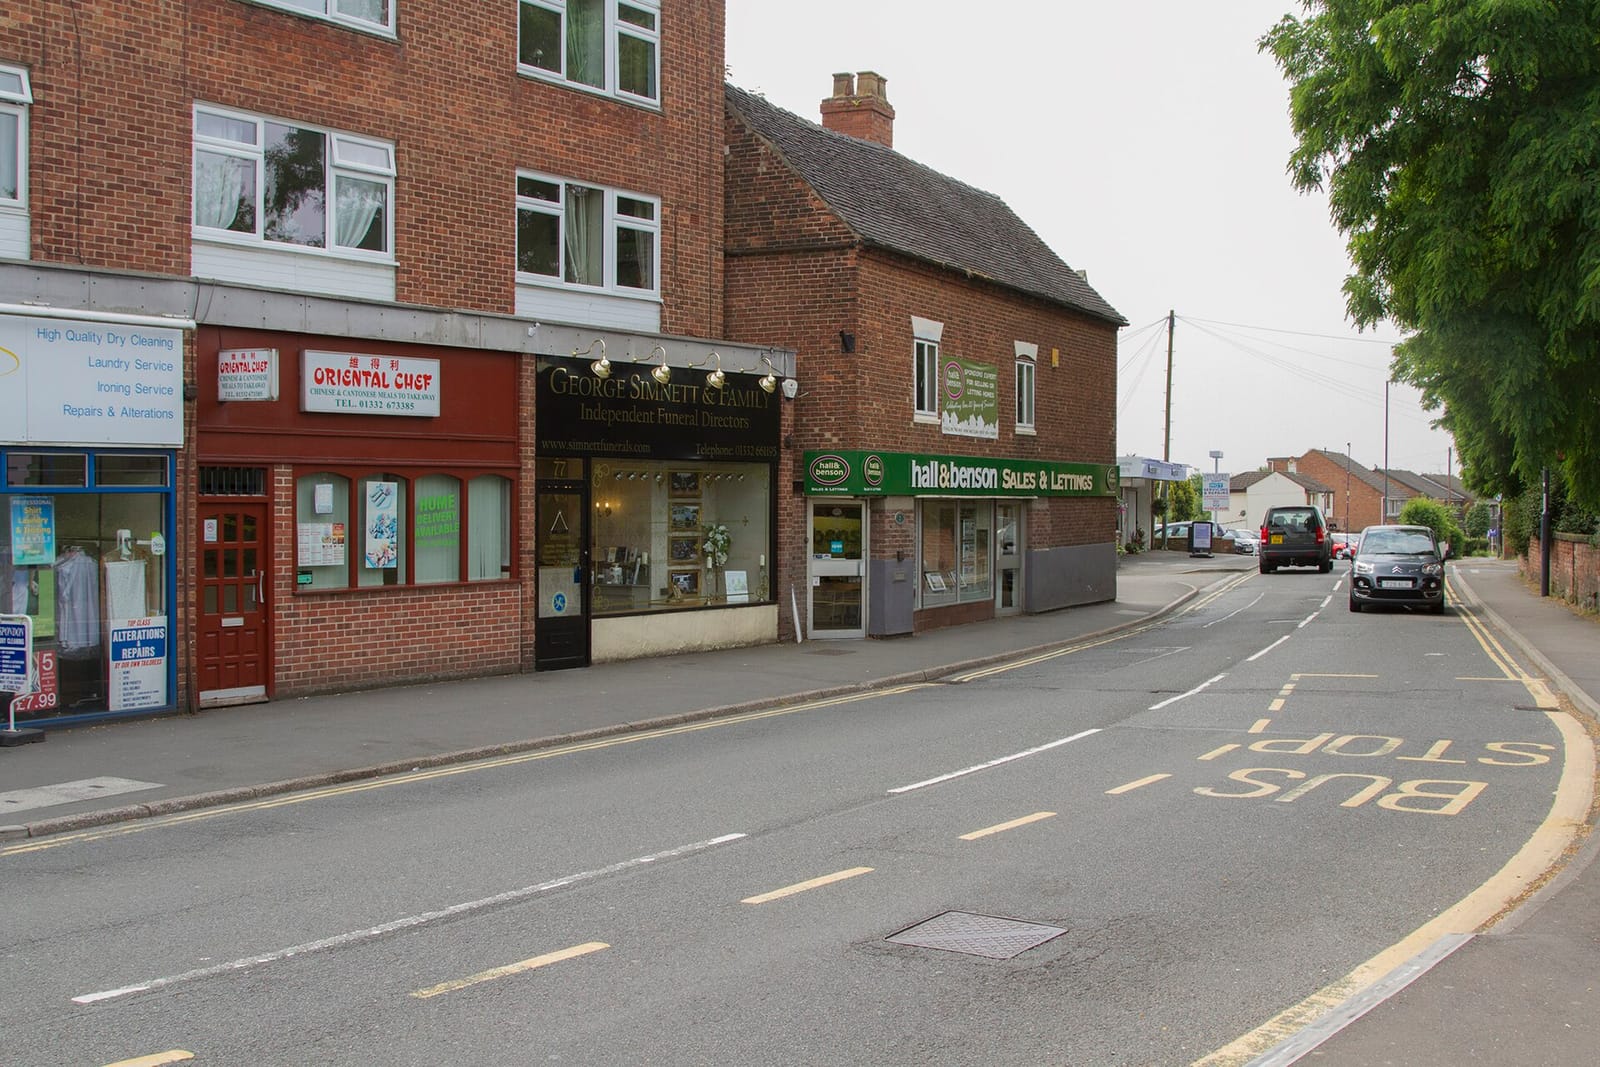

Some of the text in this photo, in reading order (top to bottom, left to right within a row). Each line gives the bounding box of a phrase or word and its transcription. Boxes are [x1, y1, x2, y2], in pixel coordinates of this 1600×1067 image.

[37, 328, 173, 349] High Quality Dry Cleaning
[88, 356, 173, 372] Laundry Service
[220, 361, 268, 374] ORIENTAL CHEF
[314, 367, 432, 391] ORIENTAL CHEF
[97, 380, 173, 395] Ironing Service
[310, 388, 335, 396] CHINESE
[342, 389, 376, 398] CANTONESE
[378, 391, 397, 399] MEALS
[407, 393, 436, 401] TAKEAWAY
[550, 367, 770, 409] GEORGE SIMNETT & FAMILY
[63, 404, 174, 420] Repairs & Alterations
[359, 400, 384, 408] 01332
[386, 401, 415, 410] 673385
[580, 403, 750, 429] Independent Funeral Directors
[541, 438, 651, 453] www.simnettfunerals.com
[553, 461, 566, 477] 77
[911, 460, 998, 489] hall&benson
[1002, 468, 1036, 490] SALES
[1039, 470, 1048, 489] &
[1051, 471, 1093, 490] LETTINGS
[419, 494, 455, 512] HOME
[416, 511, 457, 525] DELIVERY
[416, 521, 459, 536] AVAILABLE
[136, 618, 151, 626] CLASS
[113, 628, 164, 642] ALTERATIONS
[122, 647, 155, 659] REPAIRS
[43, 653, 53, 671] 5
[16, 692, 56, 711] £7.99
[1247, 733, 1555, 766] STOP
[1193, 768, 1488, 815] BUS
